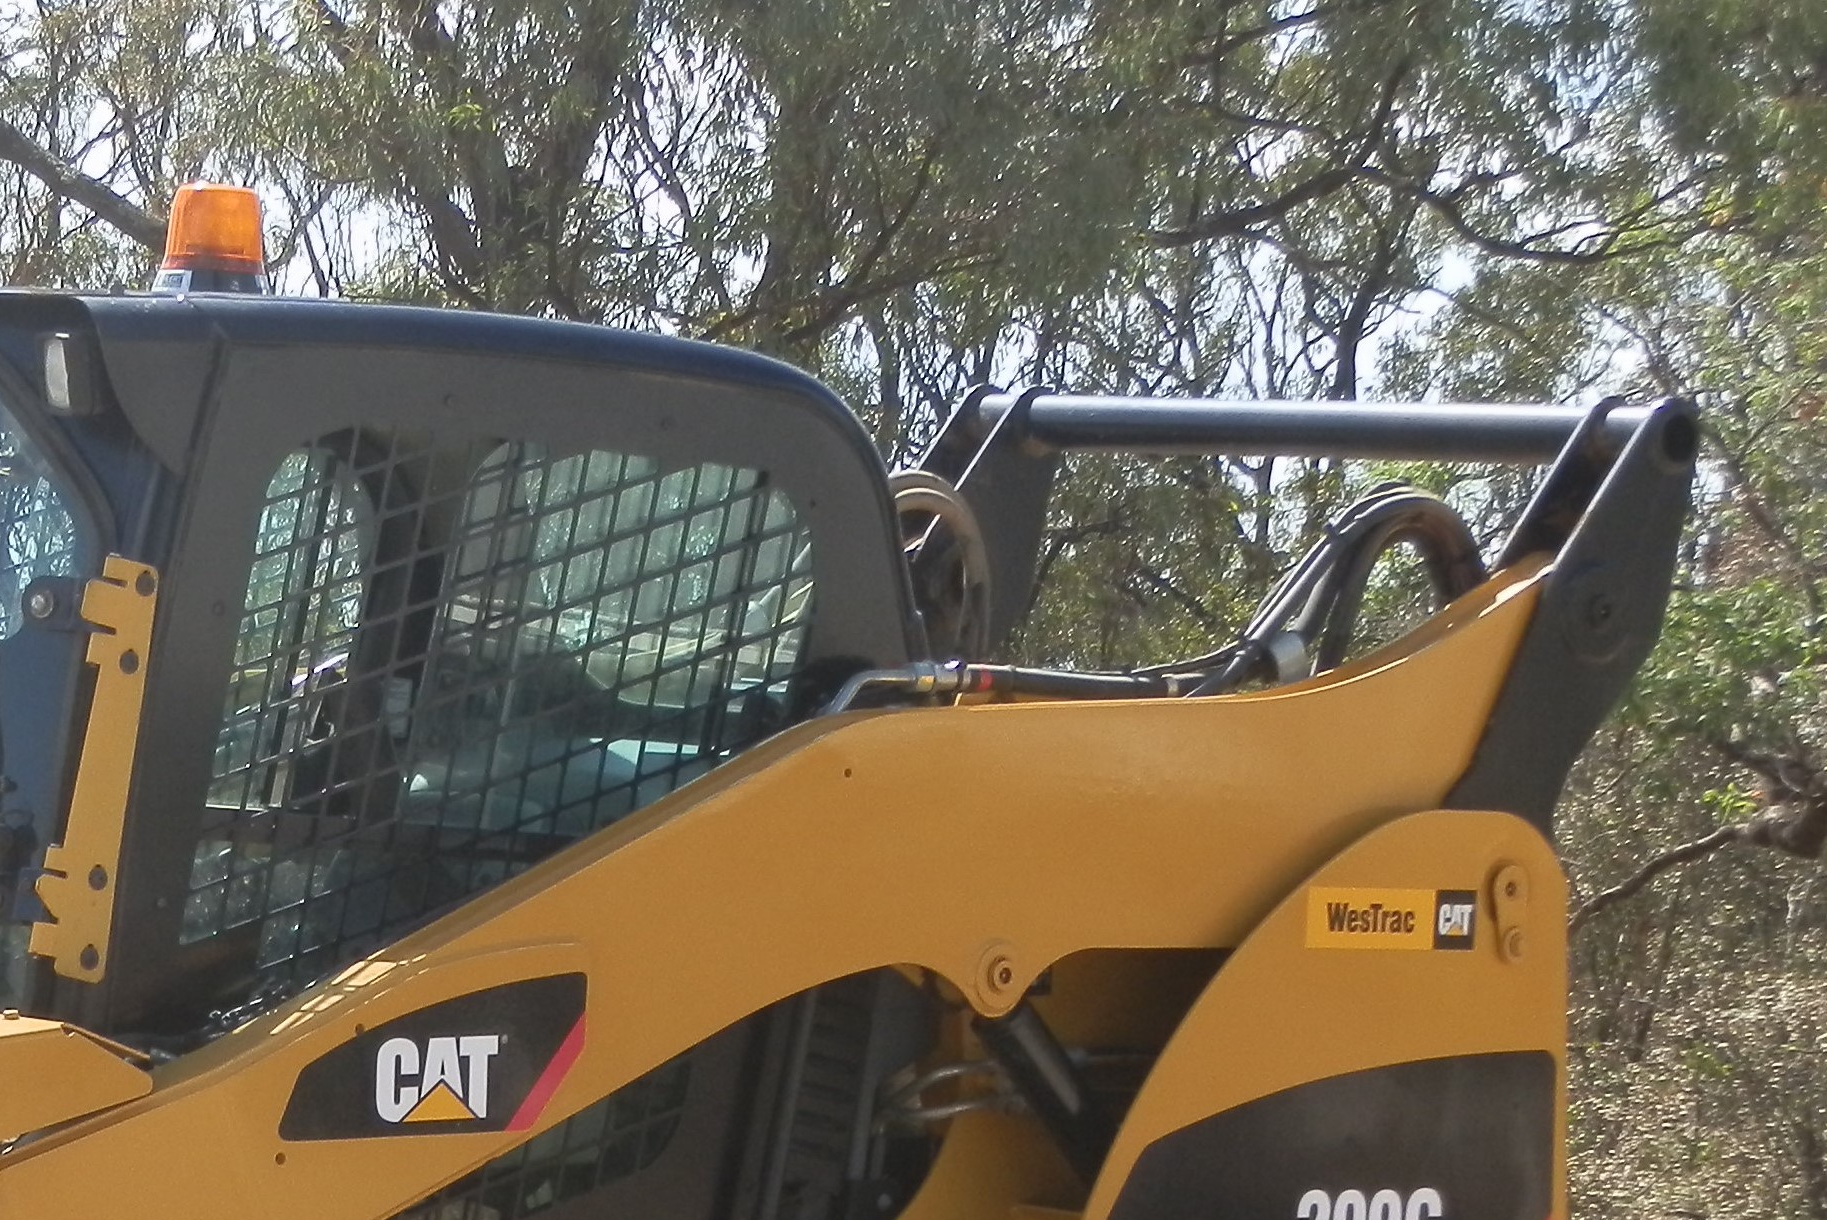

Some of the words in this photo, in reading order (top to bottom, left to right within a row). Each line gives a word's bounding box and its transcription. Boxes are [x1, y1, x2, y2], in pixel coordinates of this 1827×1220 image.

[1327, 902, 1414, 933] WesTrac
[1438, 903, 1473, 936] CAT
[376, 1035, 499, 1123] CAT
